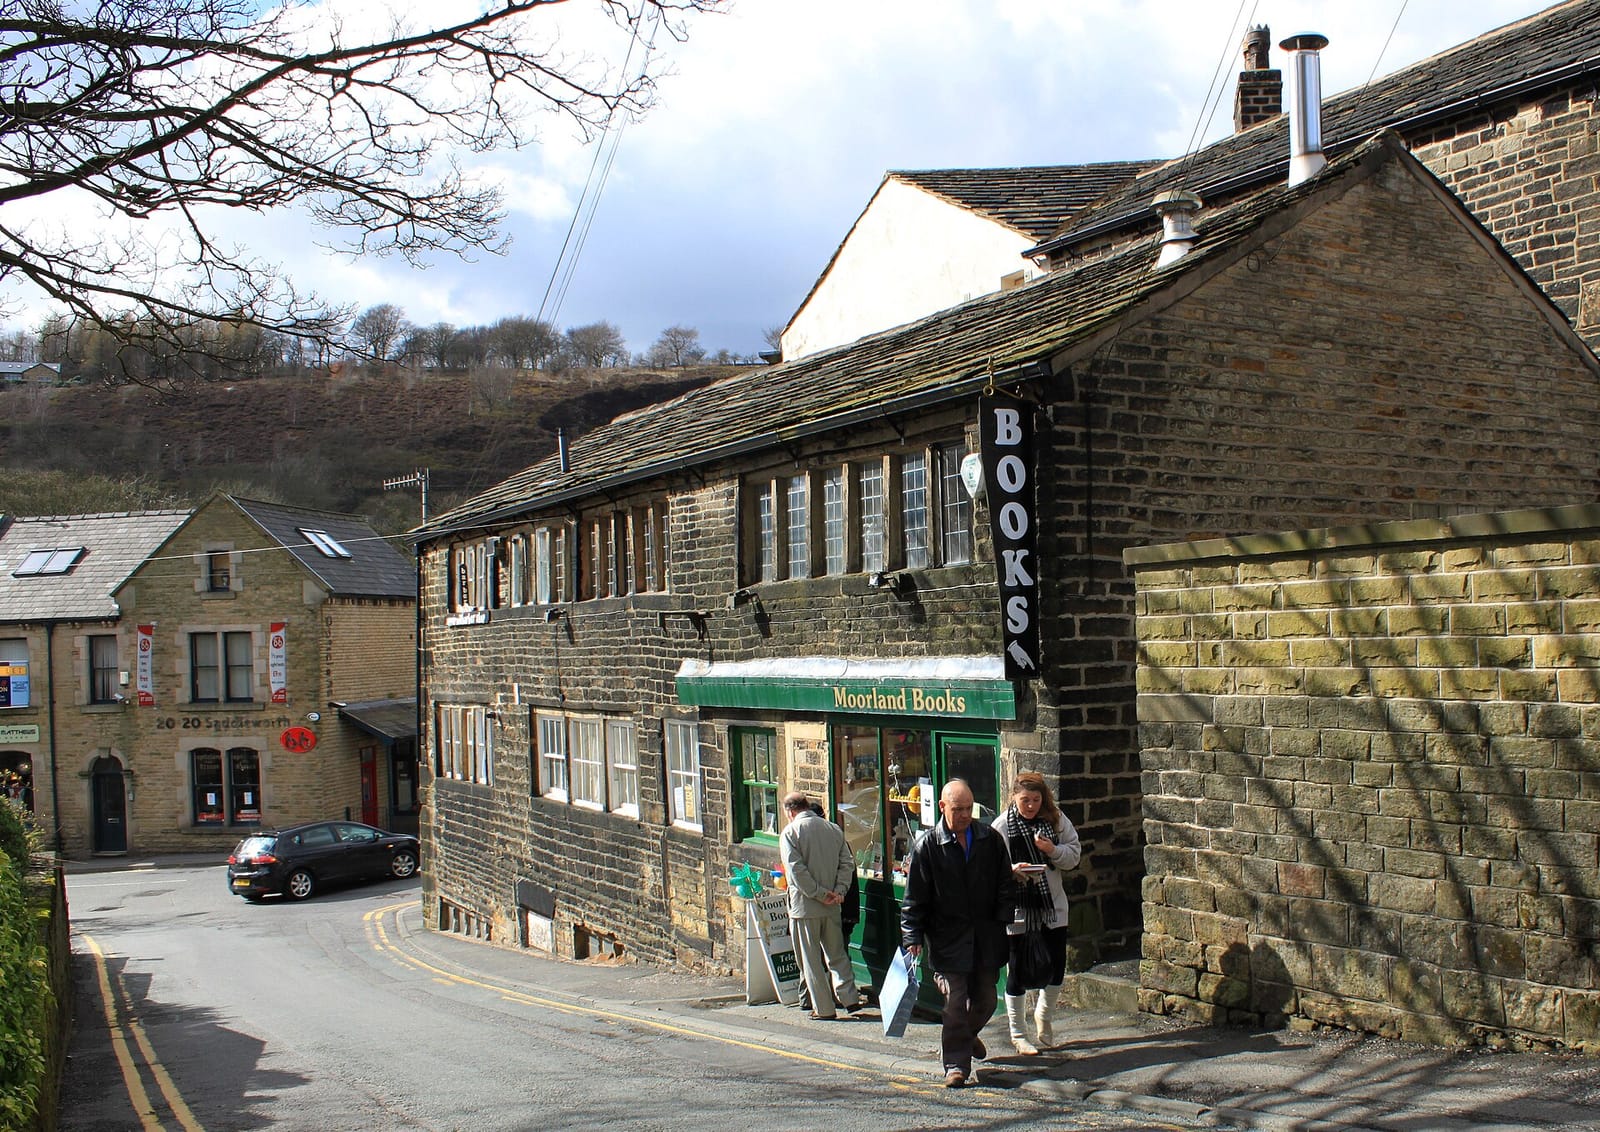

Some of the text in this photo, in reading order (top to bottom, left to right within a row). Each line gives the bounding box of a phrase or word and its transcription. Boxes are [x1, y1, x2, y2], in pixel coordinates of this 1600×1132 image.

[994, 408, 1034, 634] BOOKS
[833, 686, 966, 713] Moorland Books
[156, 717, 176, 729] 20
[182, 717, 201, 729] 20
